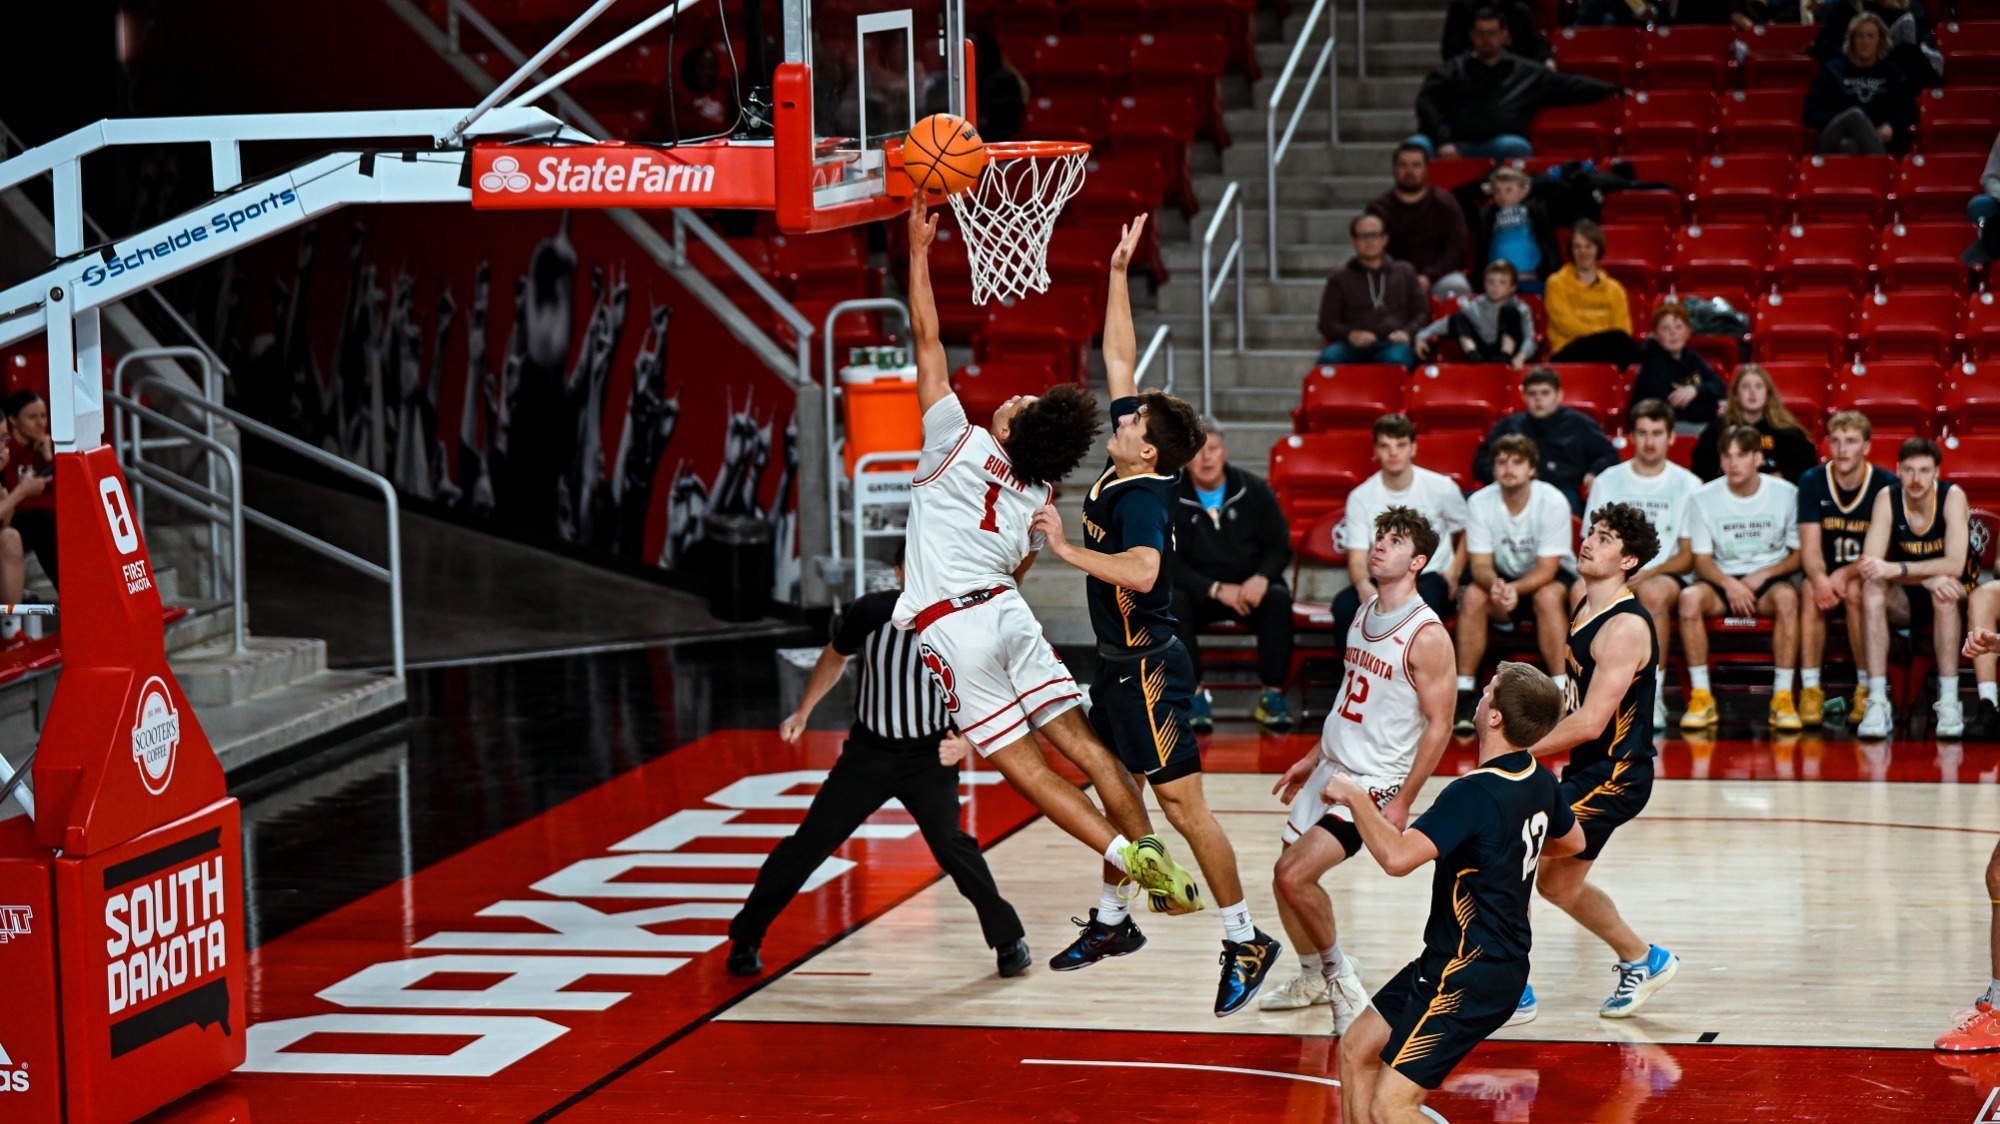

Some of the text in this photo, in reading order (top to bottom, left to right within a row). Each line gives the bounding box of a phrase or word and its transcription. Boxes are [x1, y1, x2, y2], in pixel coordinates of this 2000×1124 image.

[106, 188, 296, 278] Schelde Sports
[979, 480, 1003, 534] 1
[122, 560, 147, 582] FIRST
[127, 577, 152, 594] DAKOTA
[1359, 650, 1393, 681] DAKOTA
[1337, 669, 1370, 724] 12
[146, 744, 167, 764] COFFEE
[105, 855, 224, 958] SOUTH
[107, 918, 226, 1015] DAKOTA
